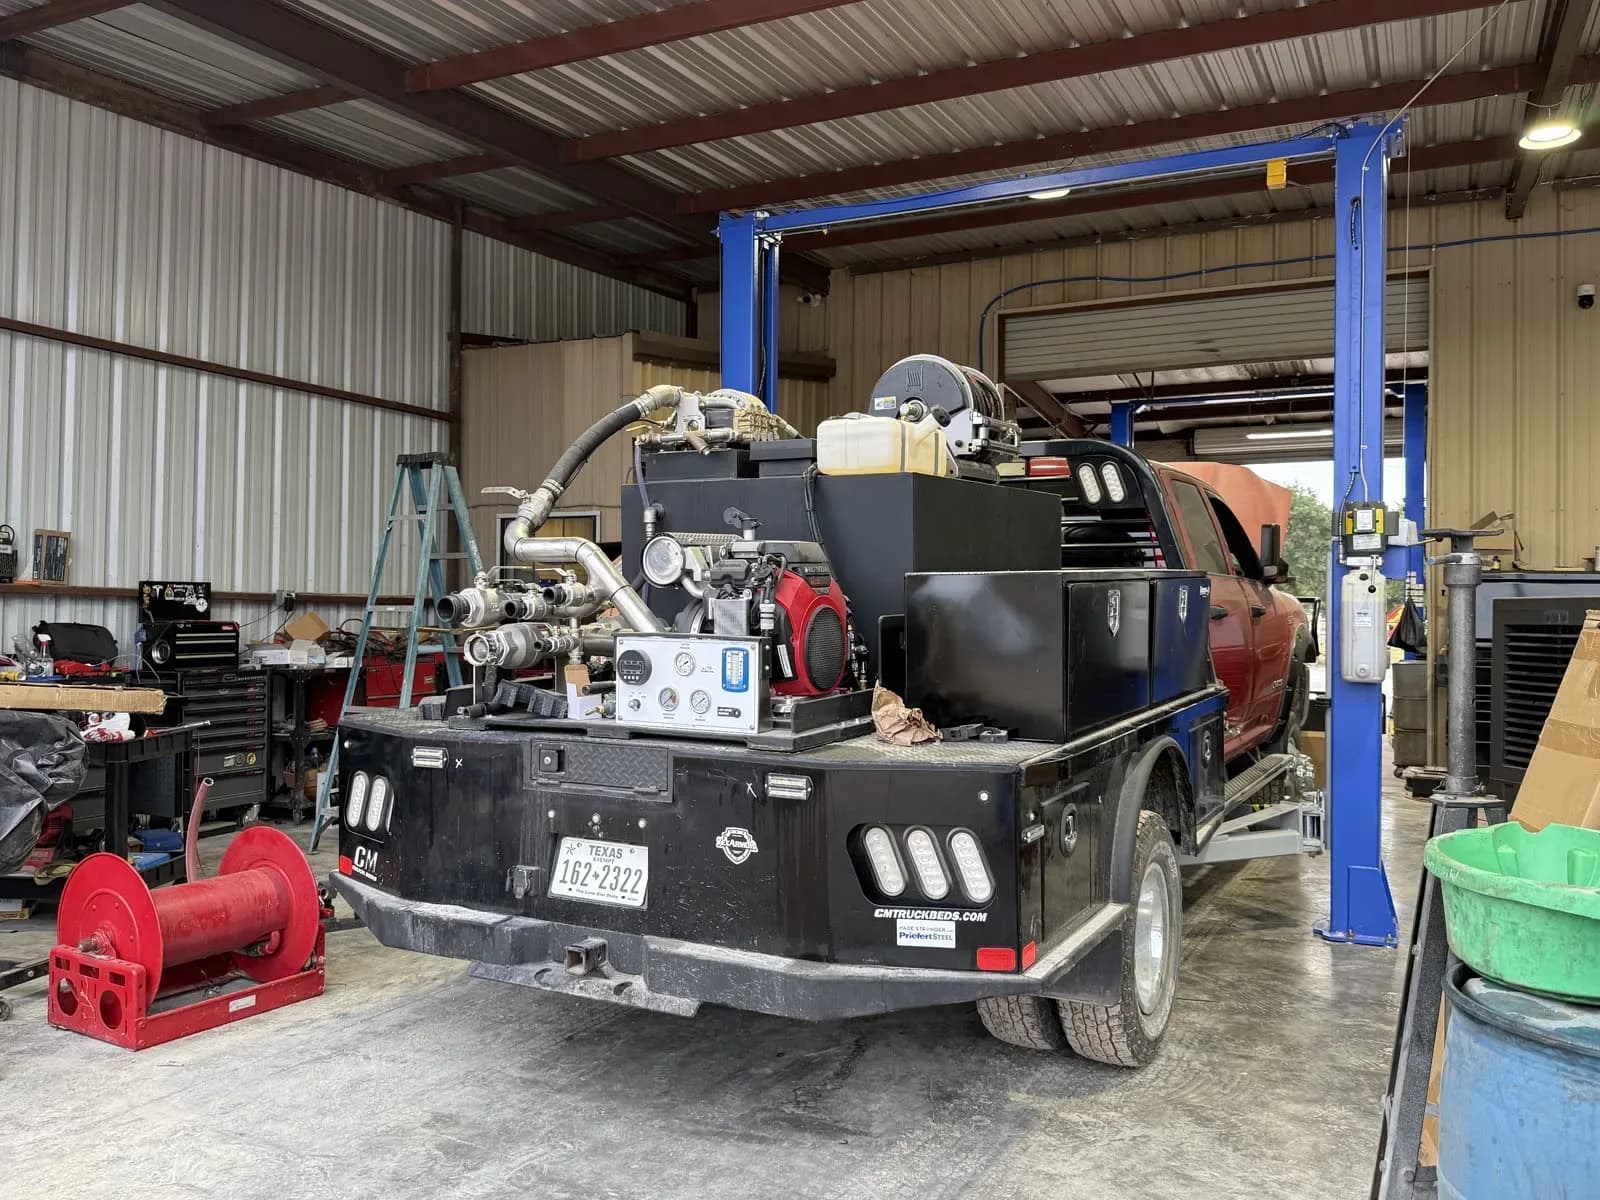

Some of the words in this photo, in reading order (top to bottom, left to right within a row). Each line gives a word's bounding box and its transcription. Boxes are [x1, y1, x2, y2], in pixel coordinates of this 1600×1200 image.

[589, 845, 623, 859] TEXAS
[354, 846, 378, 873] CM
[874, 909, 987, 922] CMTRUCKBEDS.COM
